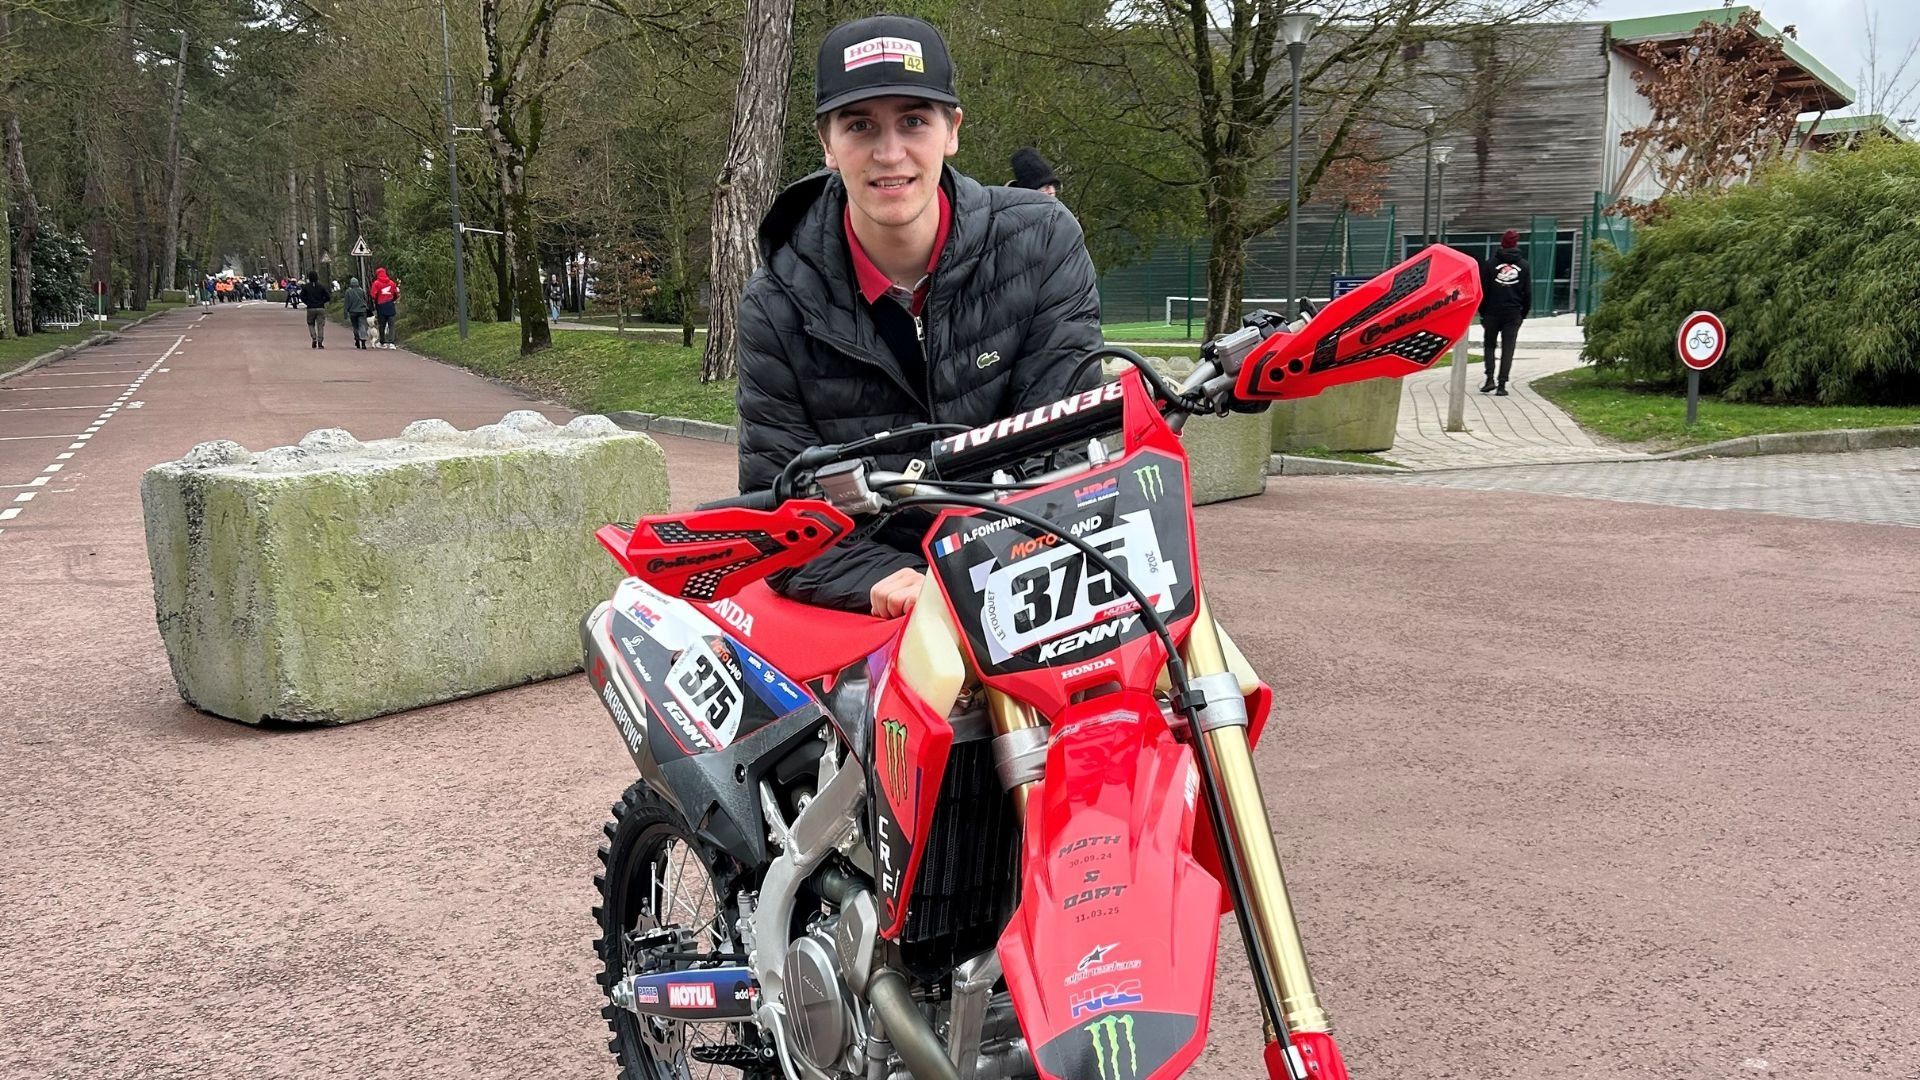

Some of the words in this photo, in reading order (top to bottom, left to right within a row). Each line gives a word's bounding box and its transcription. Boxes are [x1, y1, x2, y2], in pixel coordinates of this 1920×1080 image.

[849, 41, 916, 58] HONDA
[907, 57, 922, 70] 42
[1360, 288, 1461, 345] Polisport
[944, 381, 1123, 453] RENTHAL
[1074, 477, 1117, 504] HRC
[963, 515, 1025, 545] A.FONTAIN
[646, 548, 734, 574] Polisport
[1145, 551, 1159, 573] 2026
[1011, 537, 1129, 634] 375
[628, 601, 663, 628] HRC
[706, 598, 754, 637] NDA
[987, 590, 1000, 631] TOUQUET
[996, 629, 1006, 640] LE
[1038, 614, 1141, 663] KENNY
[1061, 658, 1116, 680] HONDA
[679, 655, 736, 730] 375
[662, 701, 711, 748] KENNY
[1076, 907, 1119, 924] 11.03.25
[669, 985, 715, 1006] MOTUL
[1070, 979, 1143, 1019] HRC
